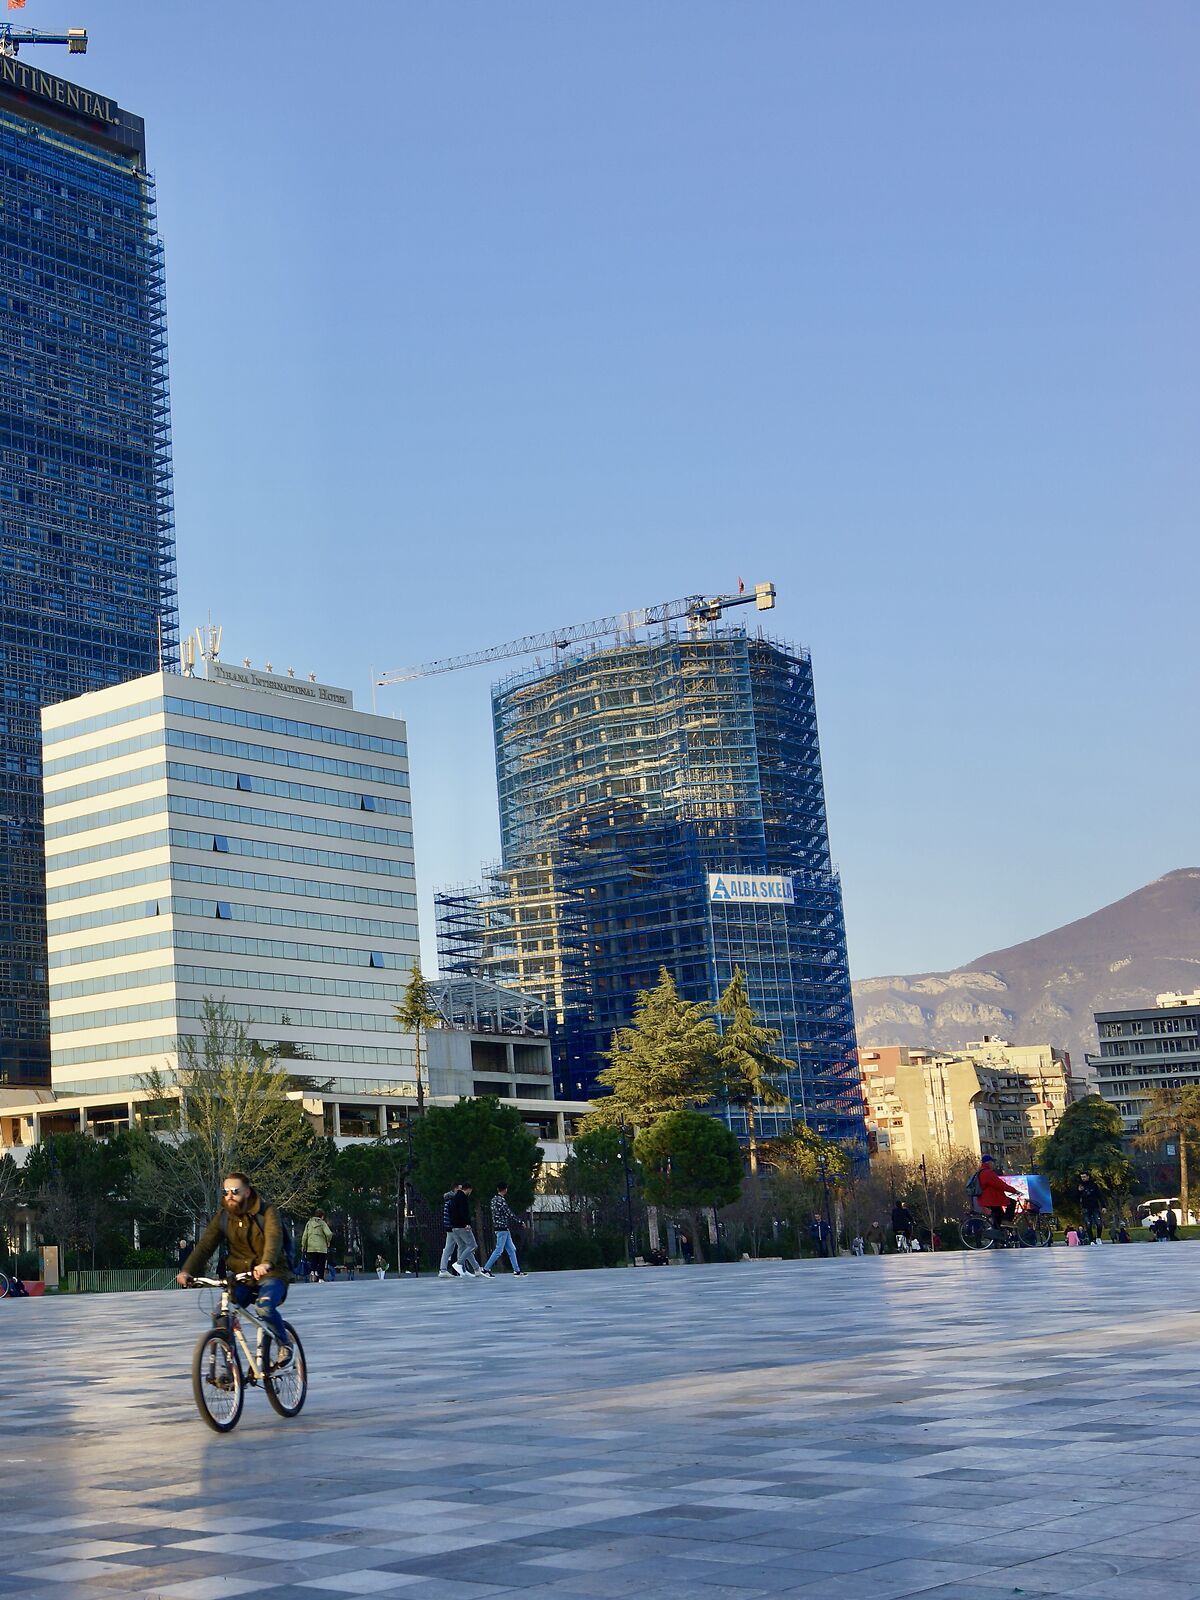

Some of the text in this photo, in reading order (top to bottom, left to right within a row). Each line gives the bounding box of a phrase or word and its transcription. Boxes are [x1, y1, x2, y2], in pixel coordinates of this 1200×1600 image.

[215, 666, 347, 704] TIRANA INTERNATIONAL HOTEL
[730, 880, 793, 899] ALBA SKELA
